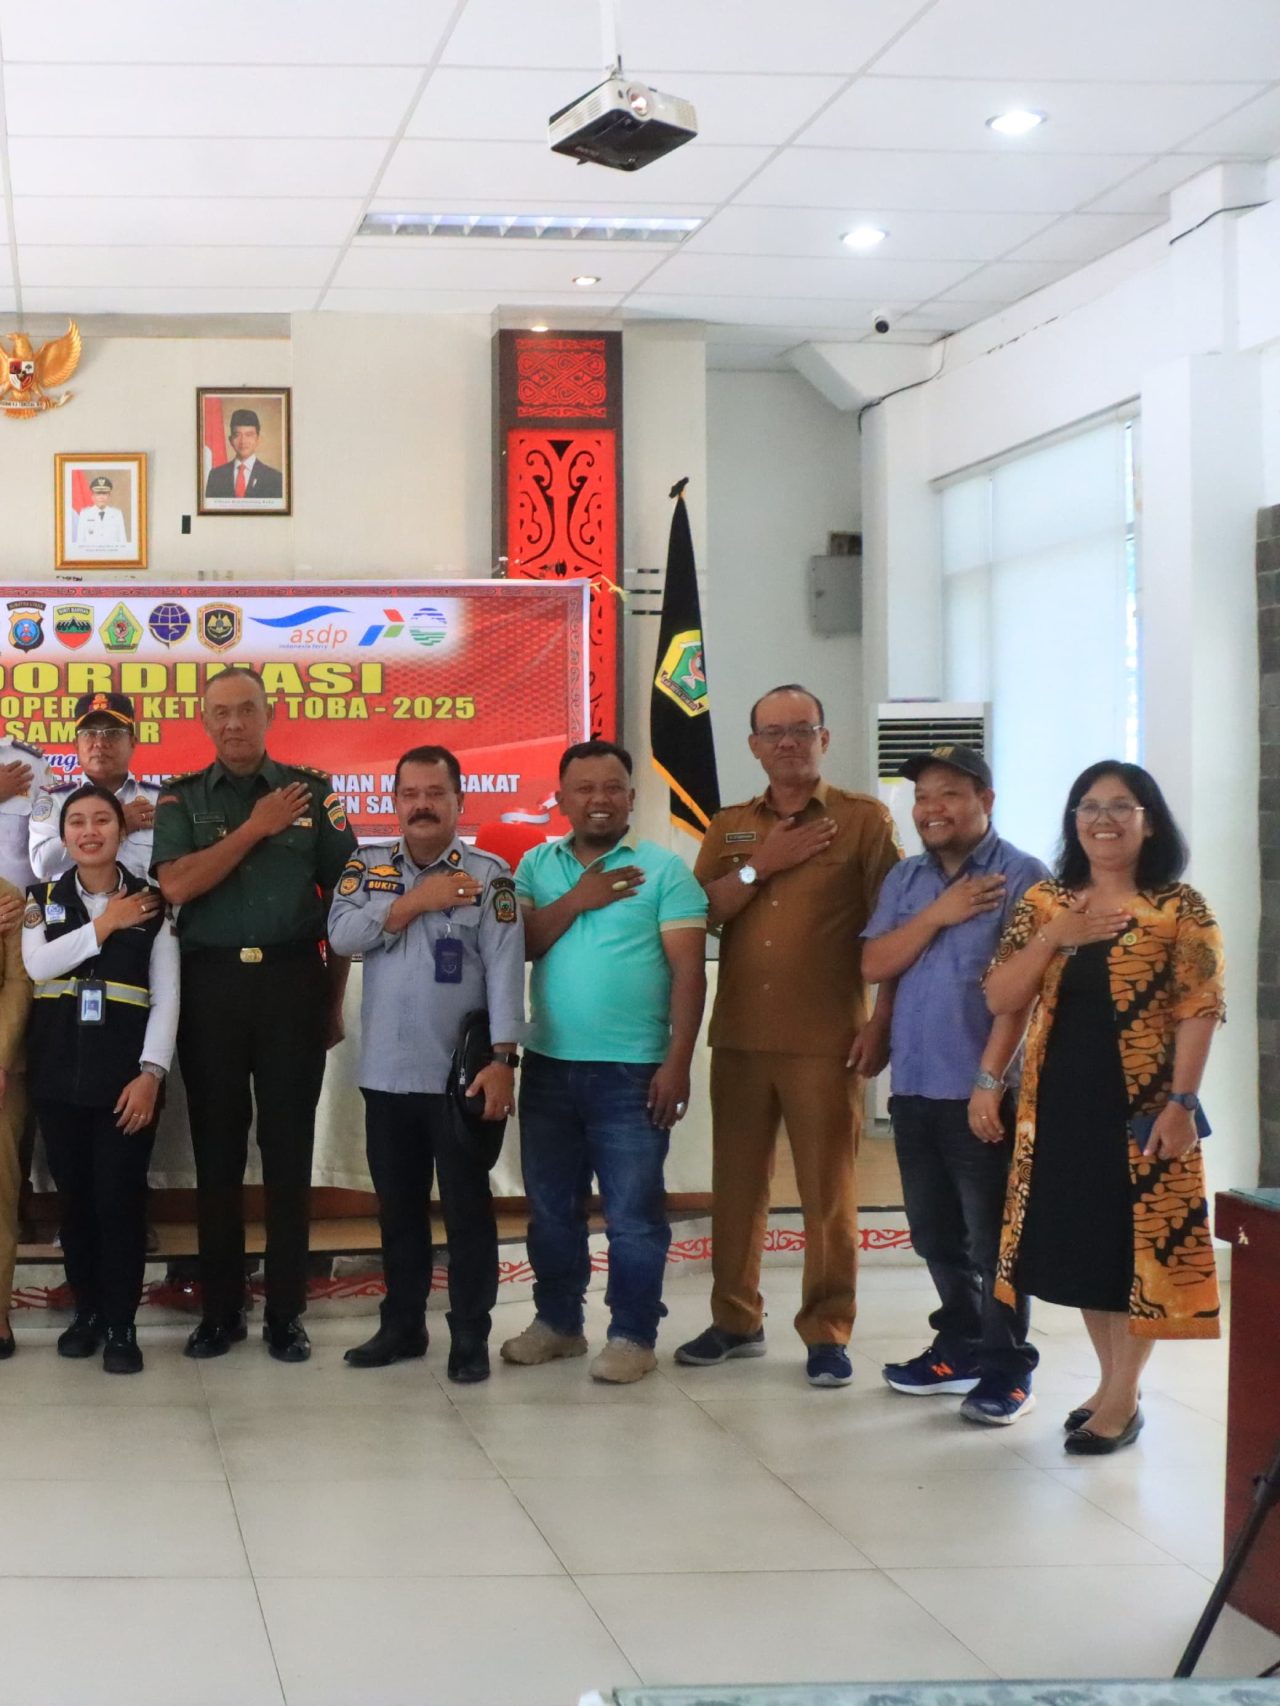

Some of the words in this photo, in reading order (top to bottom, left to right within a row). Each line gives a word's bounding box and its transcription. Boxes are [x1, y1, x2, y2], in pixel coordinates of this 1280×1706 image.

[290, 624, 348, 648] asdp
[285, 696, 369, 719] TOBA
[392, 695, 476, 719] 2025
[368, 880, 400, 892] BUKIT
